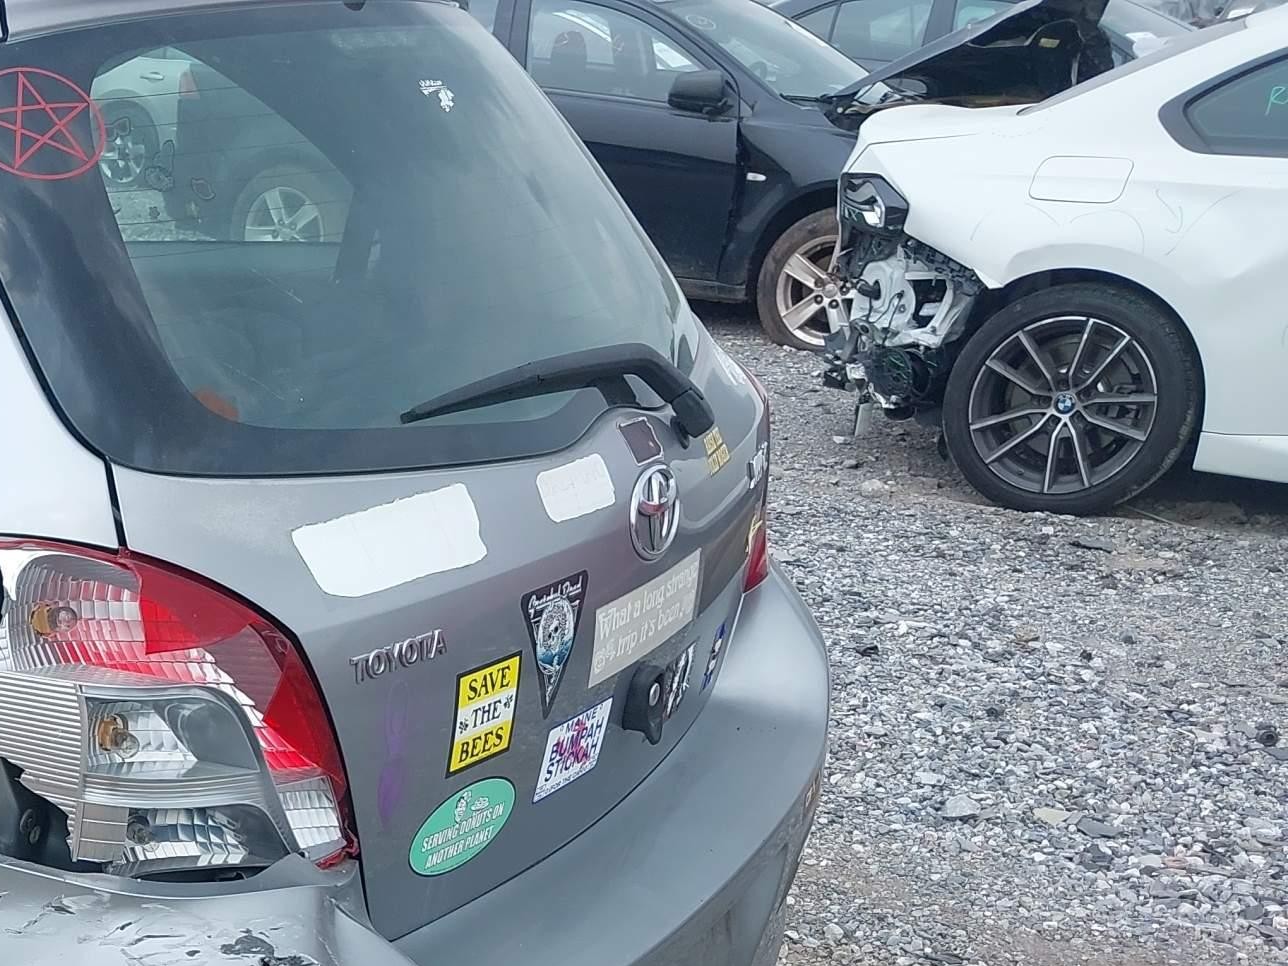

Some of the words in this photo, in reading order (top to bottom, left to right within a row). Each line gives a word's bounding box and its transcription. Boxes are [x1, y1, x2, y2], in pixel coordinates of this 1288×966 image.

[562, 575, 582, 598] Dead
[598, 602, 631, 641] What
[634, 600, 641, 618] a
[643, 585, 665, 613] long
[349, 628, 448, 684] TOYOTA
[617, 631, 638, 657] trip
[640, 621, 655, 643] it's
[467, 665, 511, 701] SAVE
[471, 700, 502, 729] THE
[565, 707, 597, 733] MAINE
[458, 727, 504, 763] BEES
[549, 716, 605, 762] BUMPAH
[545, 737, 600, 782] STICKAH
[422, 823, 460, 852] SERVING
[460, 807, 492, 834] DONUTS
[493, 802, 504, 820] ON
[425, 839, 464, 869] ANOTHER
[464, 825, 494, 851] PLANET
